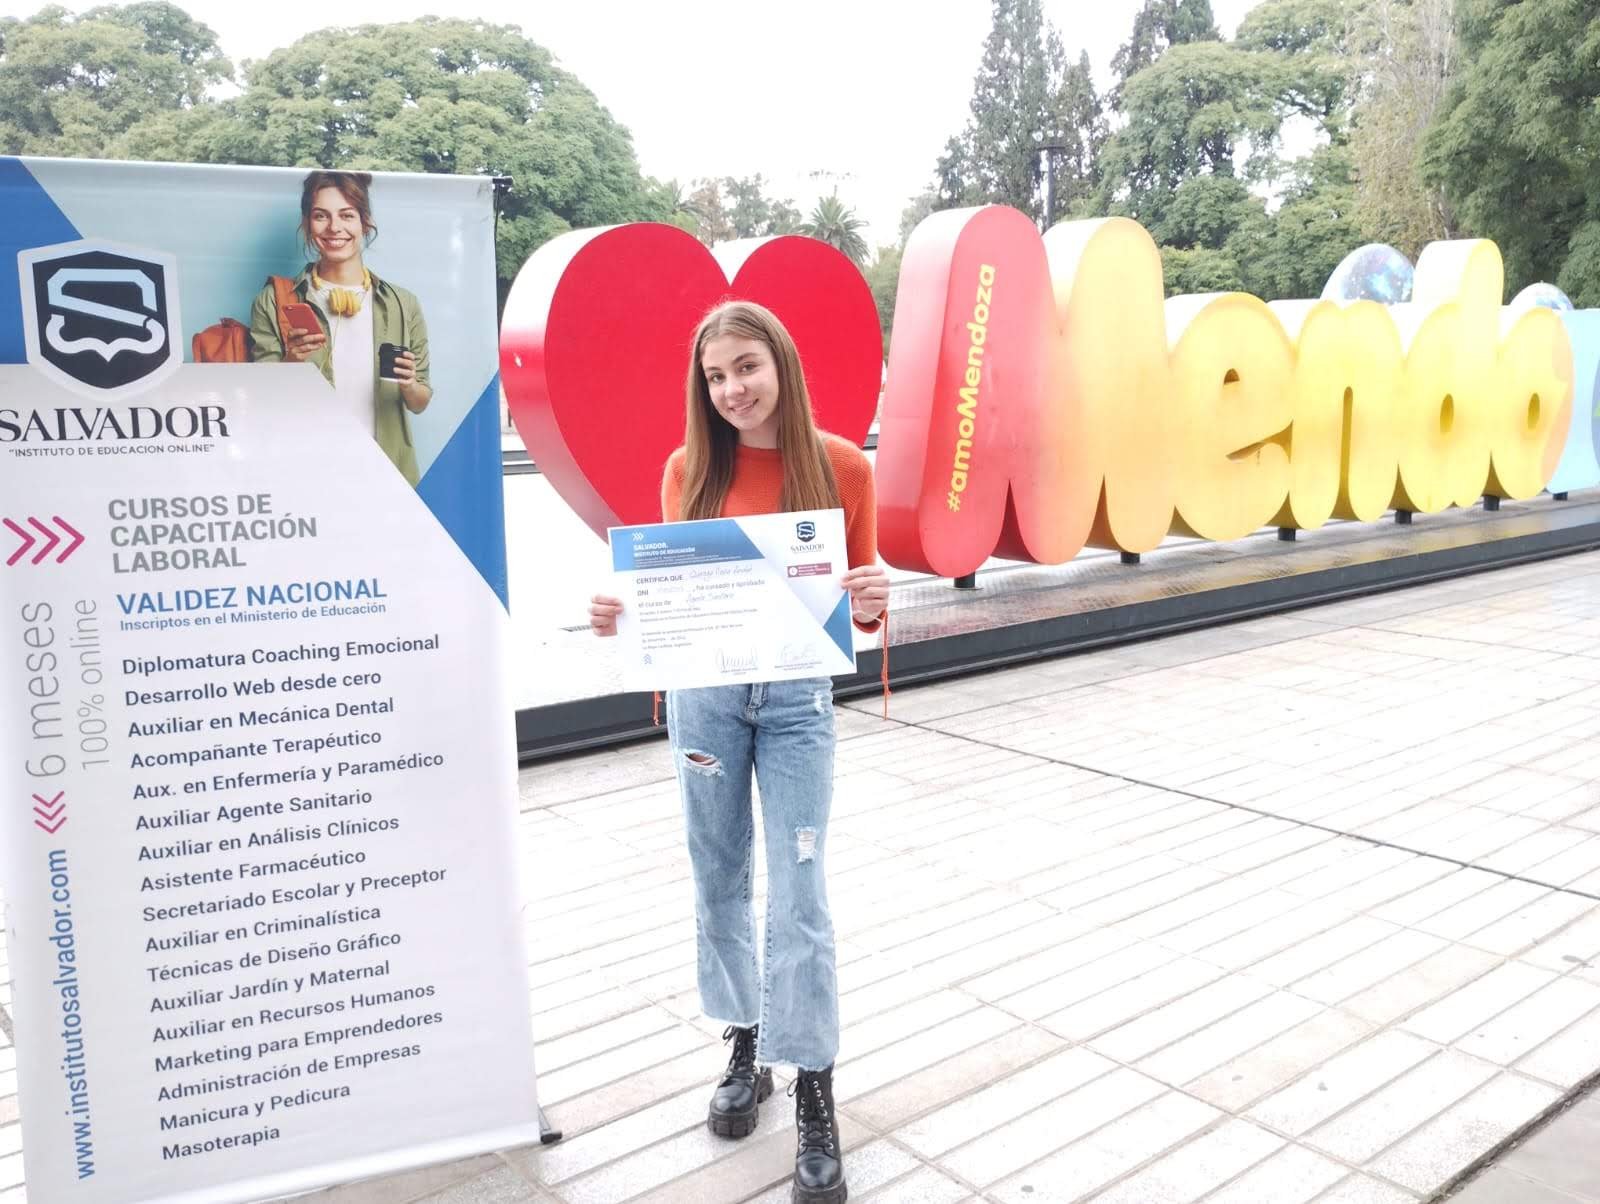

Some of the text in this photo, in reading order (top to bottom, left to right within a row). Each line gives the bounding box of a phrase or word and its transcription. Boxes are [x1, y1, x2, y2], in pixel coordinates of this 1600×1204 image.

[947, 263, 997, 513] #amoMendoza
[0, 406, 230, 442] SALVADOR
[78, 446, 94, 456] DE
[97, 445, 165, 456] EDUCACION
[107, 493, 273, 521] CURSOS DE
[109, 512, 318, 548] CAPACITACIÓN
[112, 545, 247, 575] LABORAL
[636, 575, 683, 585] CERTIFICA QUE
[115, 577, 388, 615] VALIDEZ NACIONAL
[119, 601, 387, 631] Inscriptos en el Ministerio de Educación
[121, 633, 440, 678] Diplomatura Coaching Emocional
[21, 602, 67, 778] 6 meses
[69, 599, 110, 771] 100% online
[124, 671, 382, 707] Desarrollo Web desde cero
[127, 696, 395, 739] Auxiliar en Mecánica Dental
[129, 729, 383, 769] Acompañante Terapéutico
[132, 752, 445, 801] Aux. en Enfermería y Paramédico
[135, 788, 373, 831] Auxiliar Agente Sanitario
[137, 817, 400, 862] Auxiliar en Análisis Clínicos
[139, 849, 367, 893] Asistente Farmacéutico
[142, 868, 447, 923] Secretariado Escolar y Preceptor
[145, 905, 382, 953] Auxiliar en Criminalística
[145, 932, 402, 983] Técnicas de Diseño Gráfico
[149, 959, 390, 1014] Auxiliar Jardín y Maternal
[47, 848, 95, 1181] www.institutosalvador.com
[152, 985, 436, 1044] Auxiliar en Recursos Humanos
[154, 1011, 443, 1073] Marketing para Emprendedores
[157, 1044, 421, 1103] Administración de Empresas
[159, 1085, 351, 1132] Manicura y Pedicura
[161, 1125, 281, 1161] Masoterapia
